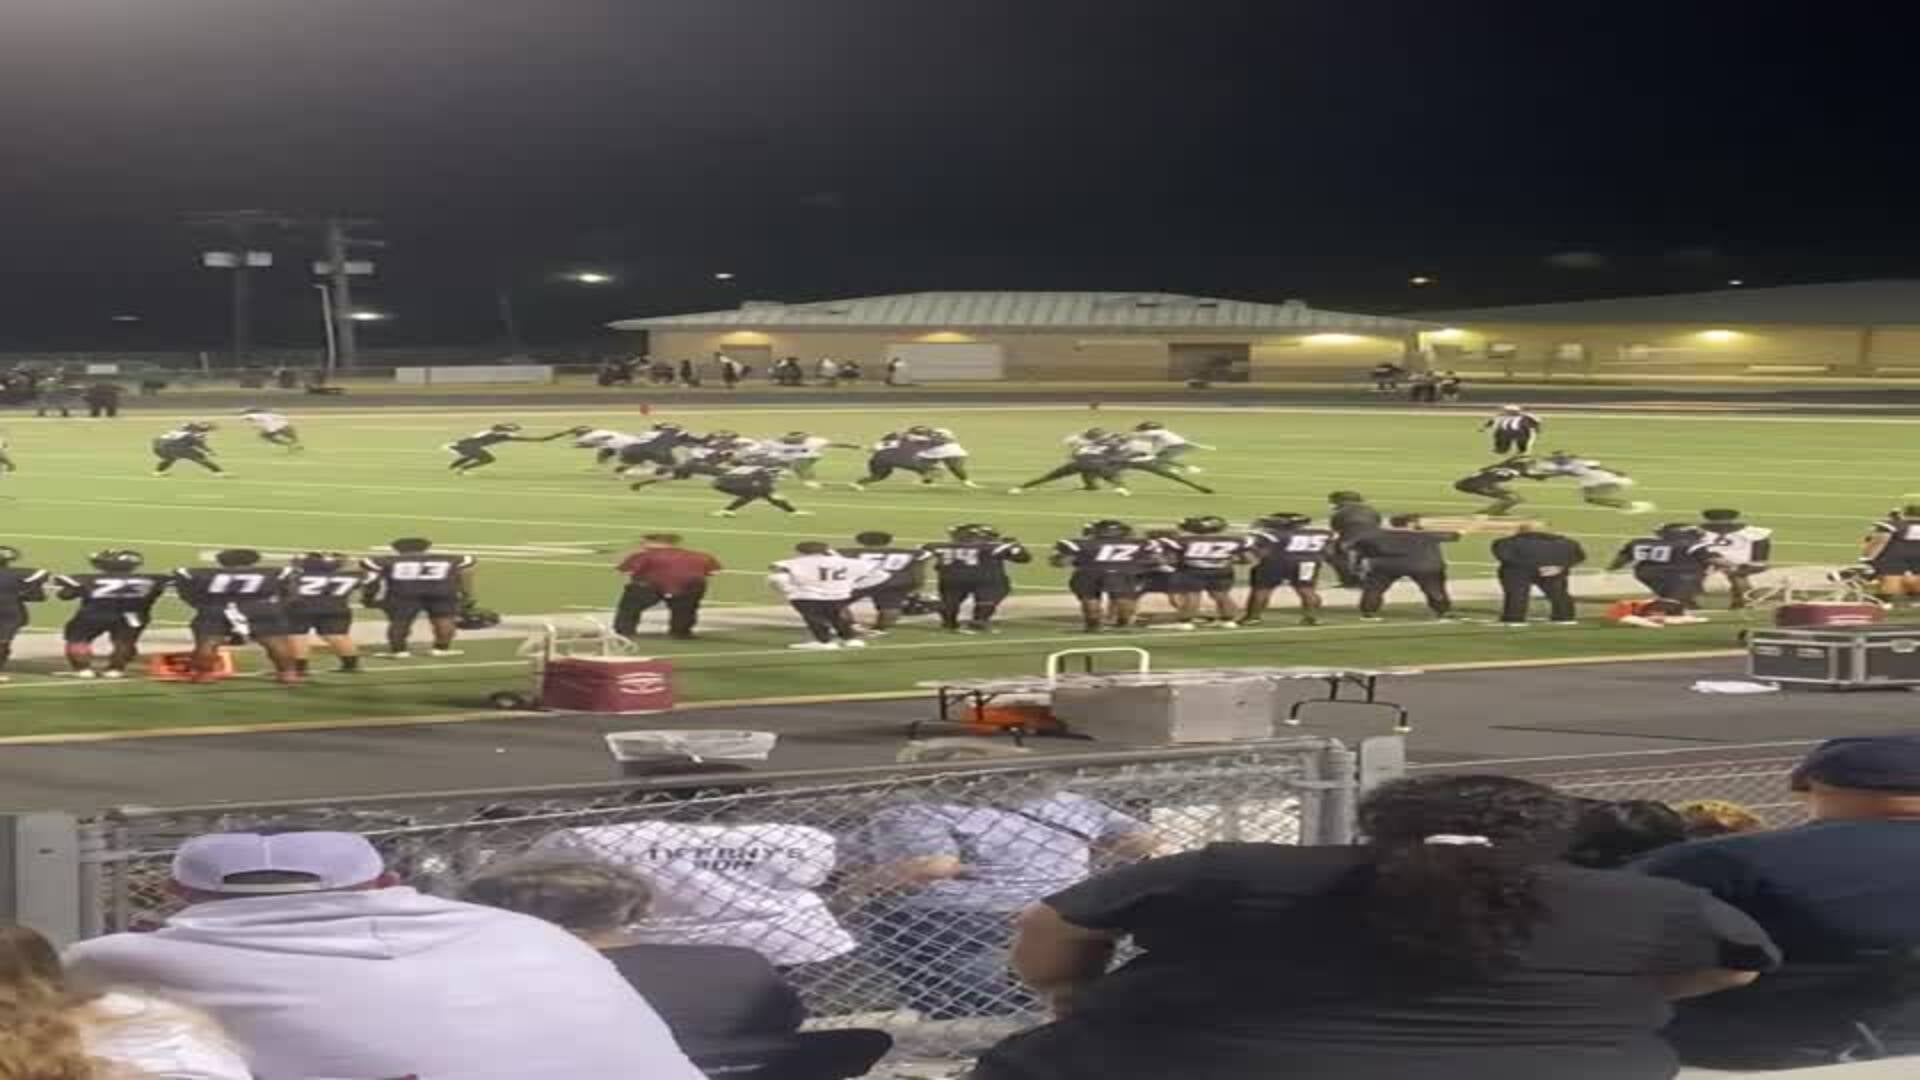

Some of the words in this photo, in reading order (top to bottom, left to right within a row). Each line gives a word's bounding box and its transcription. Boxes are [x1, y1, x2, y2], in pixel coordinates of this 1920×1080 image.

[1096, 544, 1140, 561] 12
[91, 578, 155, 599] 23
[208, 573, 265, 593] 17
[298, 576, 358, 595] 27
